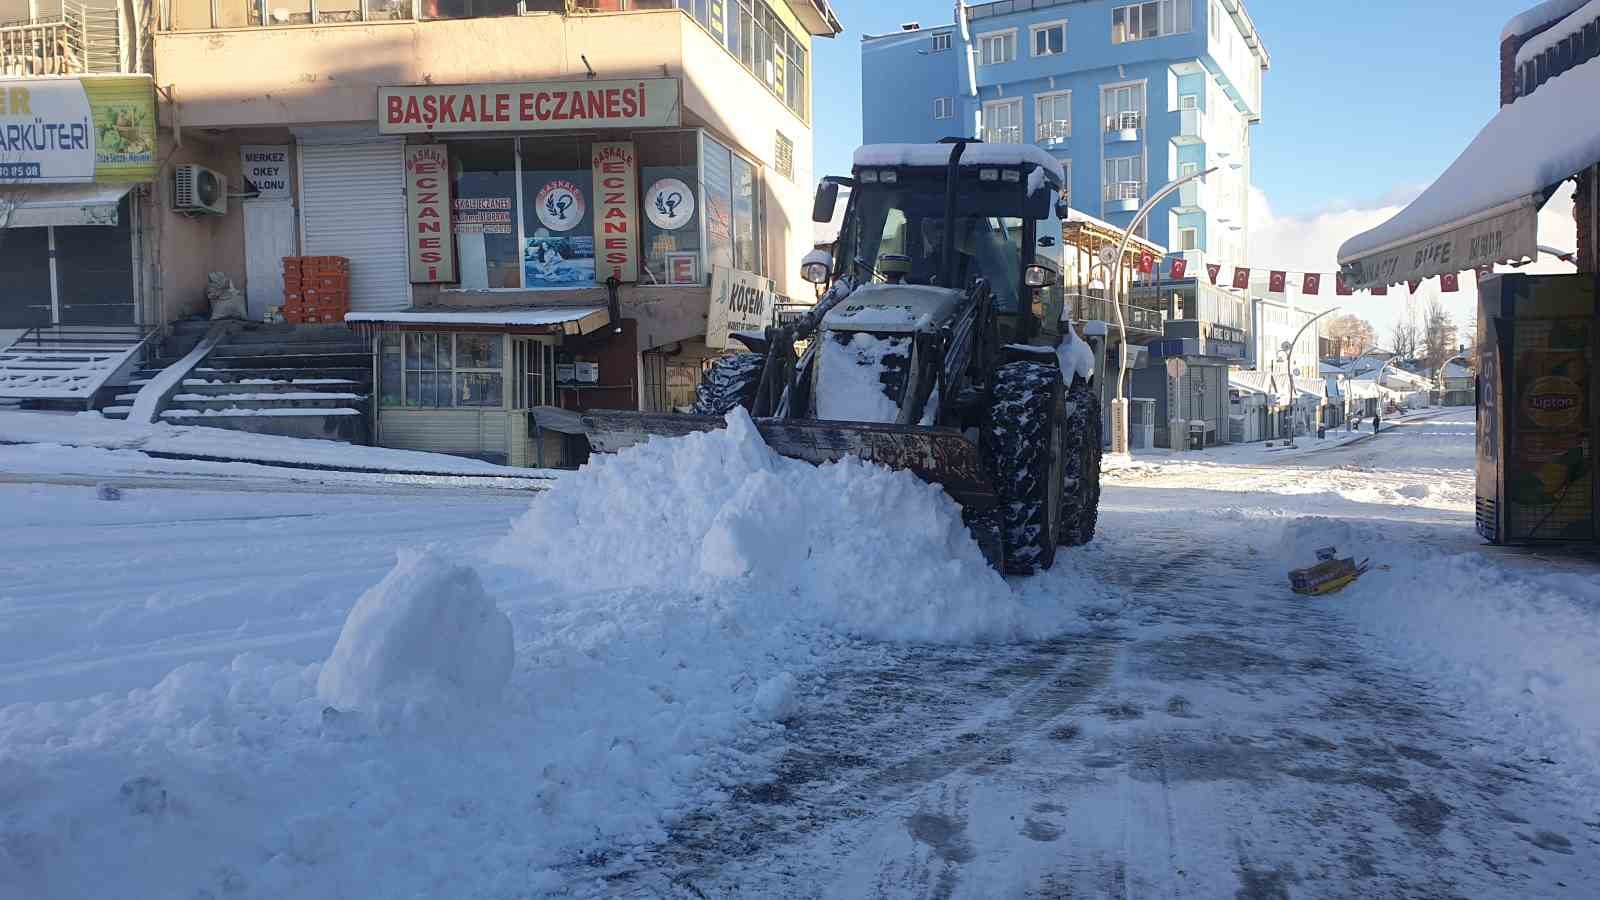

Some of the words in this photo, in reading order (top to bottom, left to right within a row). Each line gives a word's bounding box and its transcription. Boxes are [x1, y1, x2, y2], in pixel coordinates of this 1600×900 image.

[386, 93, 511, 130] BAŞKALE
[519, 82, 646, 121] ECZANESİ
[245, 152, 285, 162] MERKEZ
[252, 167, 279, 177] OKEY
[415, 162, 443, 281] ECZANESİ
[602, 162, 628, 280] ECZANESİ
[1414, 241, 1452, 271] BÜFE
[729, 279, 765, 321] KÖŞEM
[1532, 397, 1573, 410] Lipton
